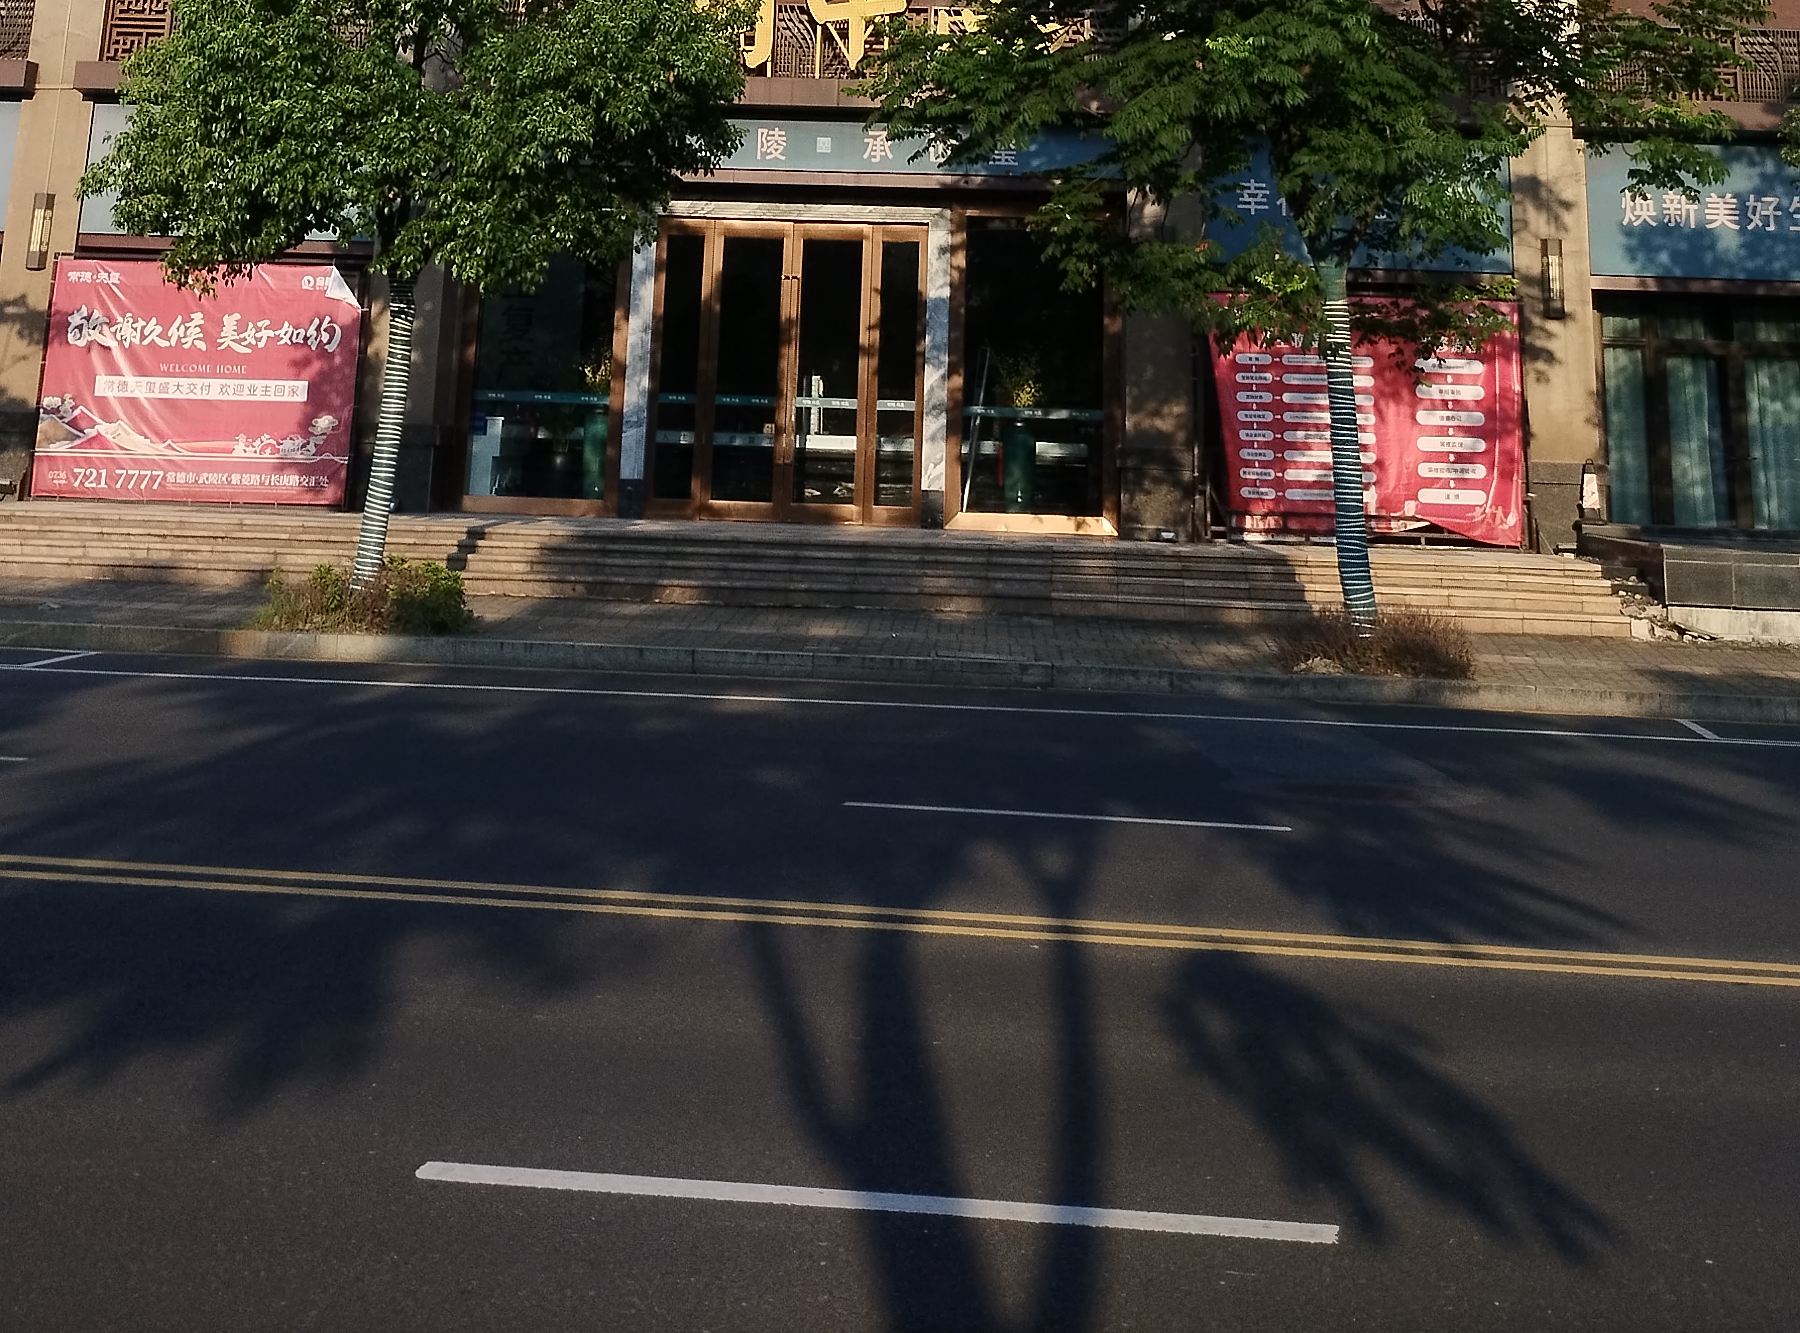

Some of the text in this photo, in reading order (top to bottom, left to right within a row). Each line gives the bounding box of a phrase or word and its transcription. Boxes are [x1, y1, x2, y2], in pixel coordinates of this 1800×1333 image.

[67, 304, 342, 353] 敬谢久候 美好如约
[159, 363, 247, 374] WELCOME HOME
[218, 383, 300, 398] 欢迎业主回家
[73, 467, 108, 488] 721
[115, 469, 164, 490] 7777
